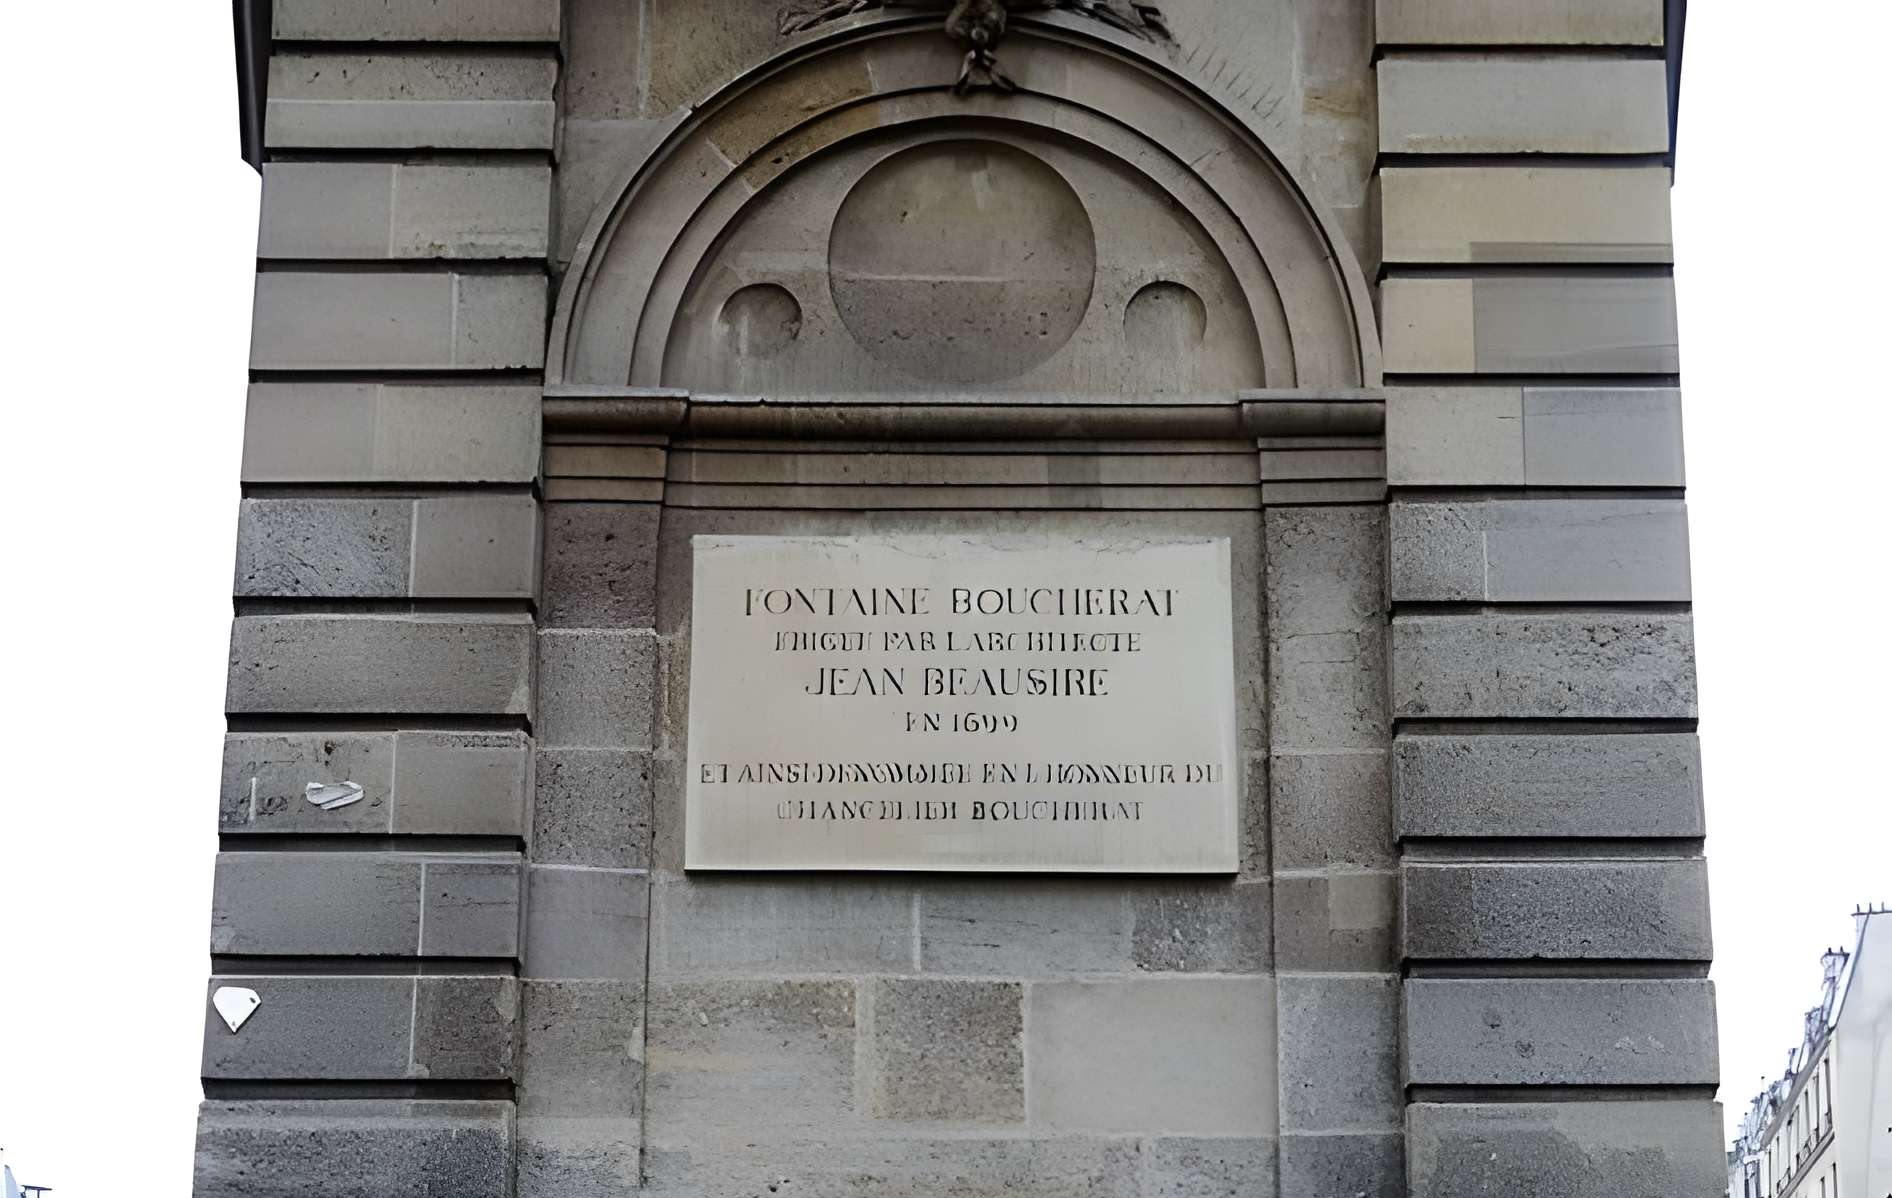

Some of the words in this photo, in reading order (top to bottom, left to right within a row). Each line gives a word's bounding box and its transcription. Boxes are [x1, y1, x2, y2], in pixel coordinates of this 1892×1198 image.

[745, 587, 931, 616] FONTAINE
[952, 587, 1178, 617] BOUCHERAT
[883, 631, 937, 652] PAR
[804, 666, 905, 696] JEAN
[922, 666, 1110, 697] BEAUSIRE
[952, 711, 1020, 734] 1699
[700, 763, 729, 784] ET
[737, 763, 809, 784] AINSI
[970, 800, 1144, 821] BOUCHAT
